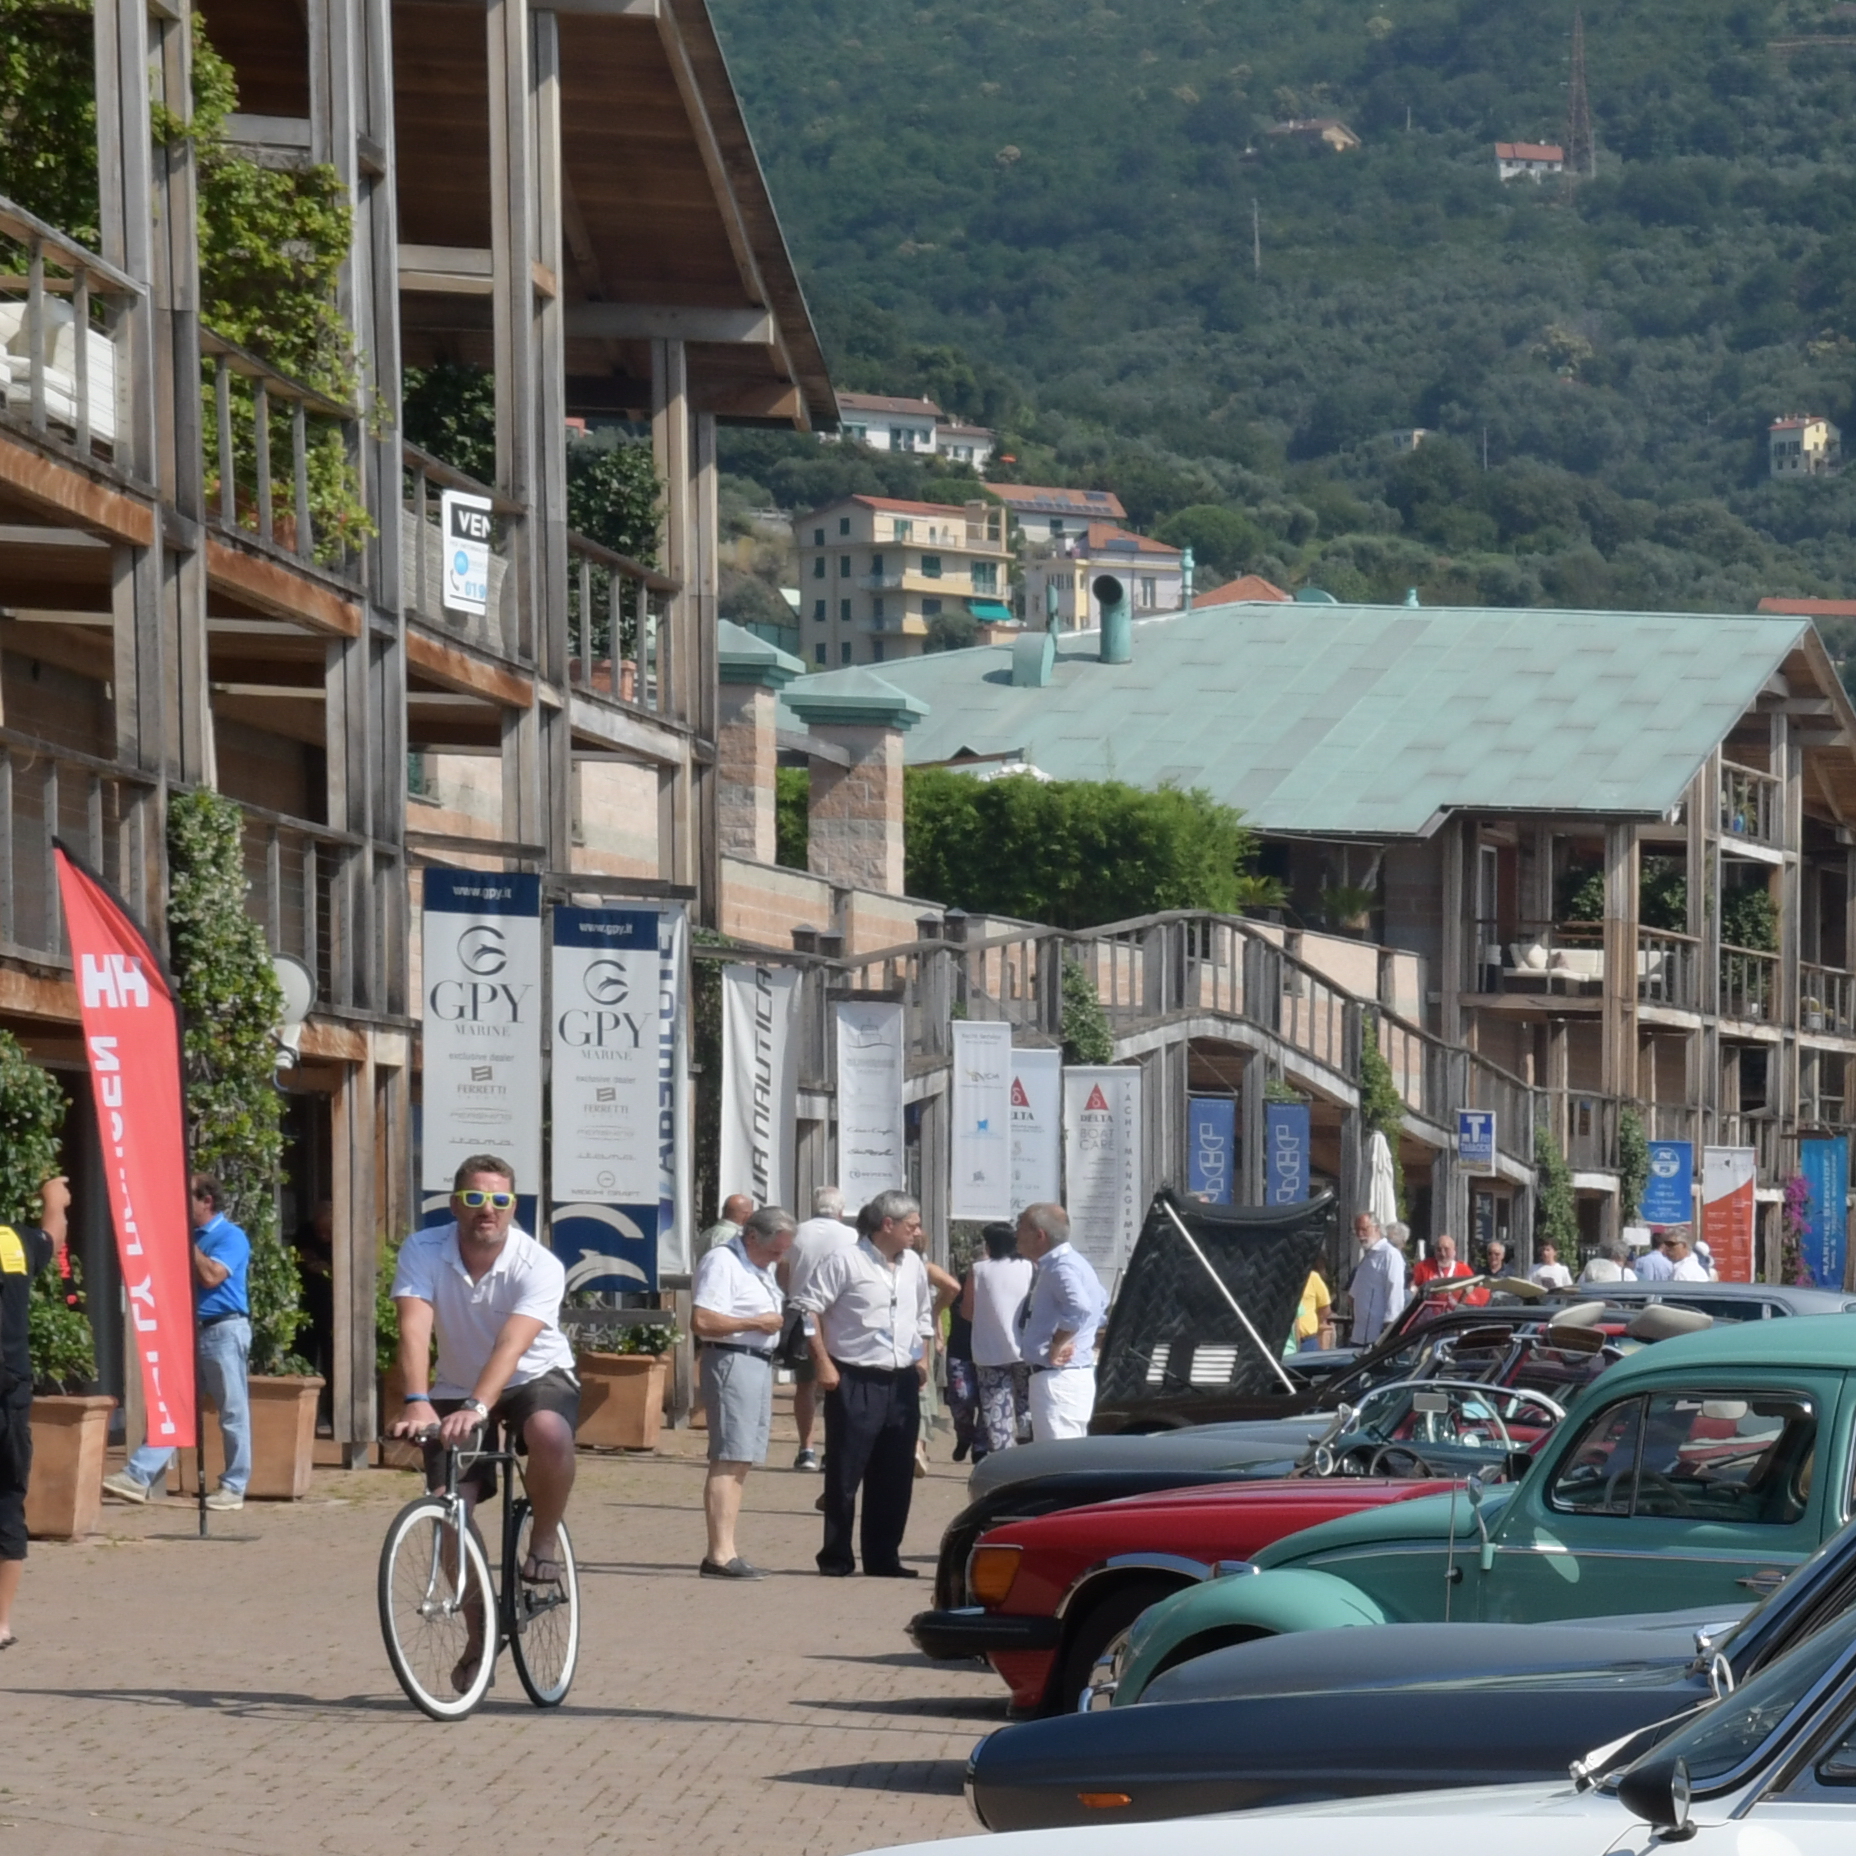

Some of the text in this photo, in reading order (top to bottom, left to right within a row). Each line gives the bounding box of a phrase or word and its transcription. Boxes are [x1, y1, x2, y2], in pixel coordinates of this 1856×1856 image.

[452, 886, 512, 900] www.gpy.it
[578, 922, 633, 936] www.gpy.it
[429, 979, 535, 1024] GPY
[455, 1024, 512, 1038] MARINE
[557, 1009, 654, 1049] GPY
[449, 1053, 515, 1063] exclusive dealer
[581, 1049, 632, 1061] MARINE
[753, 967, 773, 1139] NAUTICA
[457, 1084, 507, 1095] FERRETTI
[583, 1104, 629, 1114] FERRETTI
[1123, 1081, 1132, 1139] YACHT
[1080, 1114, 1113, 1123] DELTA
[1080, 1129, 1115, 1139] BOAT
[1079, 1139, 1115, 1151] CARE
